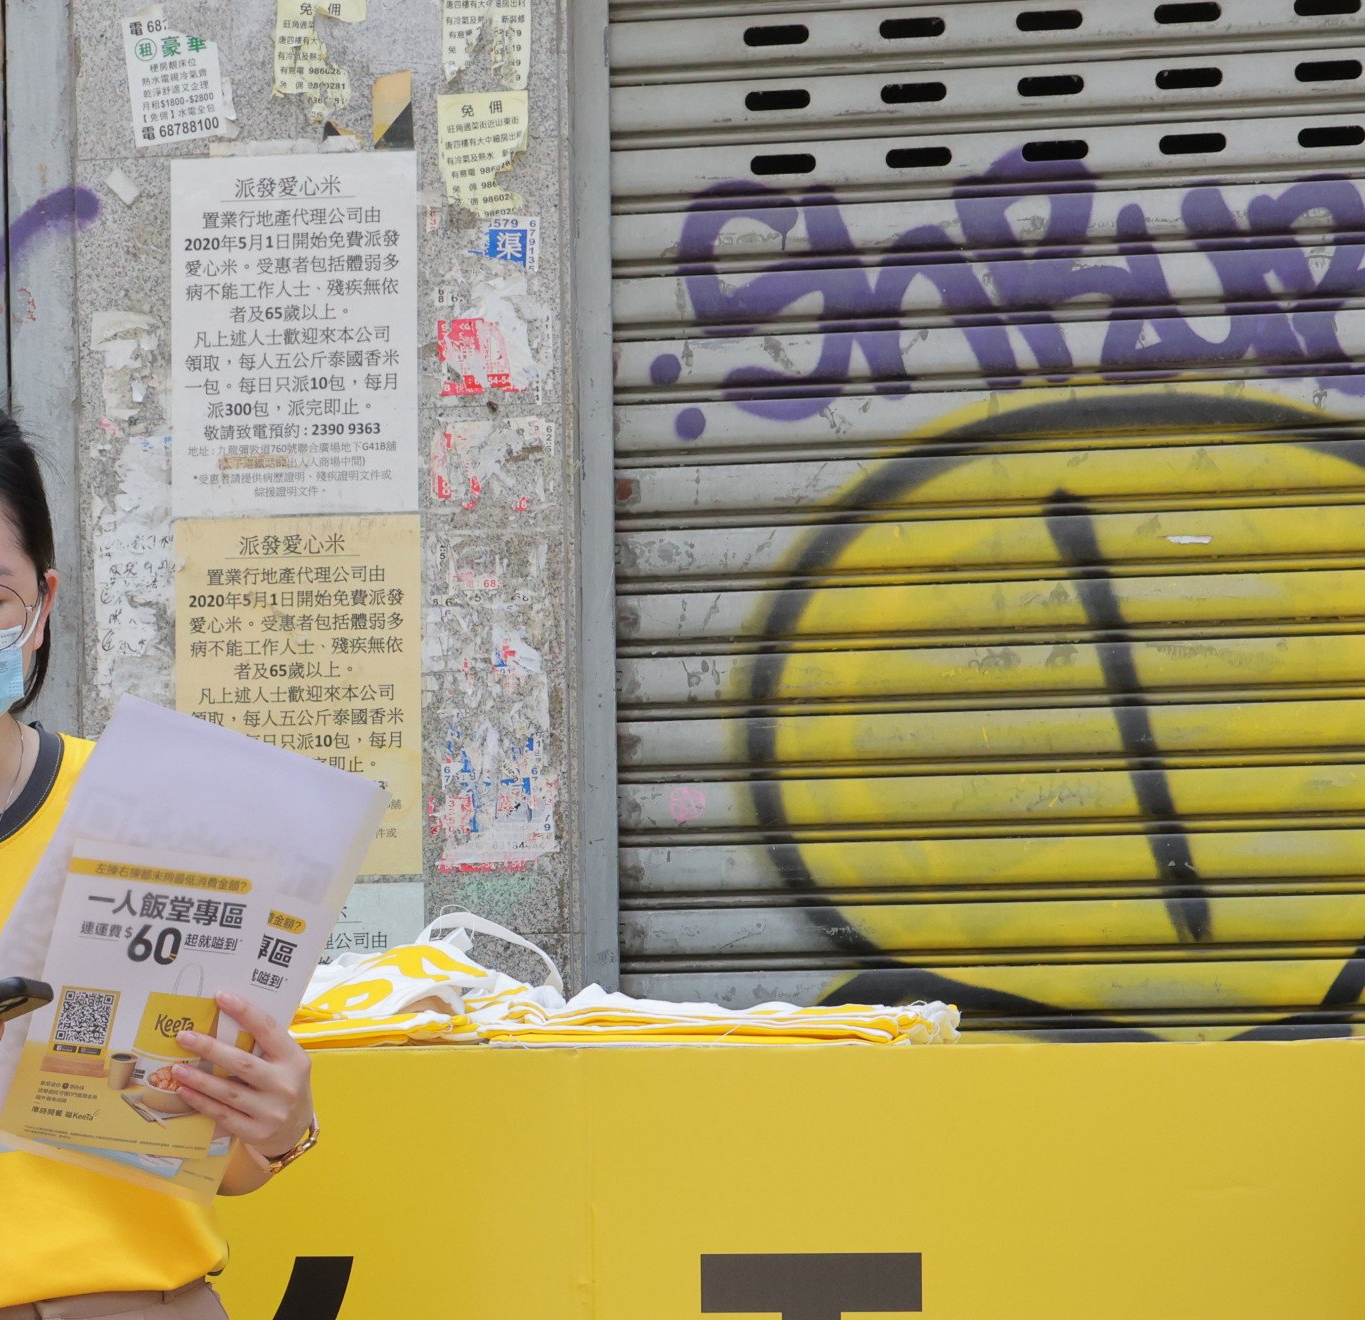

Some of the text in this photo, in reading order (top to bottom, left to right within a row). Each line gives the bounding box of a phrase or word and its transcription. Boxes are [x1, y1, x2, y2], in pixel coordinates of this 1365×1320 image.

[129, 21, 143, 36] 電
[139, 43, 152, 57] 租
[142, 116, 219, 140] 電 68788100
[235, 175, 342, 199] 派發愛心米
[202, 206, 381, 230] 置業行地產代理公司由
[488, 219, 519, 228] 579
[184, 229, 401, 253] 2020年5月1日開始免費派發
[185, 253, 399, 278] 愛心米。受惠者包括體弱多
[186, 277, 399, 301] 病不能工作人士、殘疾無依
[229, 303, 349, 324] 者及65歲以上。
[194, 325, 391, 349] 凡上述人士歡迎來本公司
[311, 423, 344, 436] 2390
[348, 422, 381, 435] 9363
[239, 533, 345, 556] 派發愛心米
[206, 565, 385, 586] 置業行地產代理公司由
[189, 588, 405, 610] 2020年5月1日開始免費派發
[189, 611, 404, 635] 愛心米。受惠者包括體弱多
[190, 636, 404, 658] 病不能工作人士、殘疾無依
[234, 661, 354, 681] 者及65歲以上。
[198, 683, 395, 706] 凡上述人士歡迎來本公司
[88, 889, 247, 929] 一人飯堂專區
[155, 1013, 195, 1038] KeeTa
